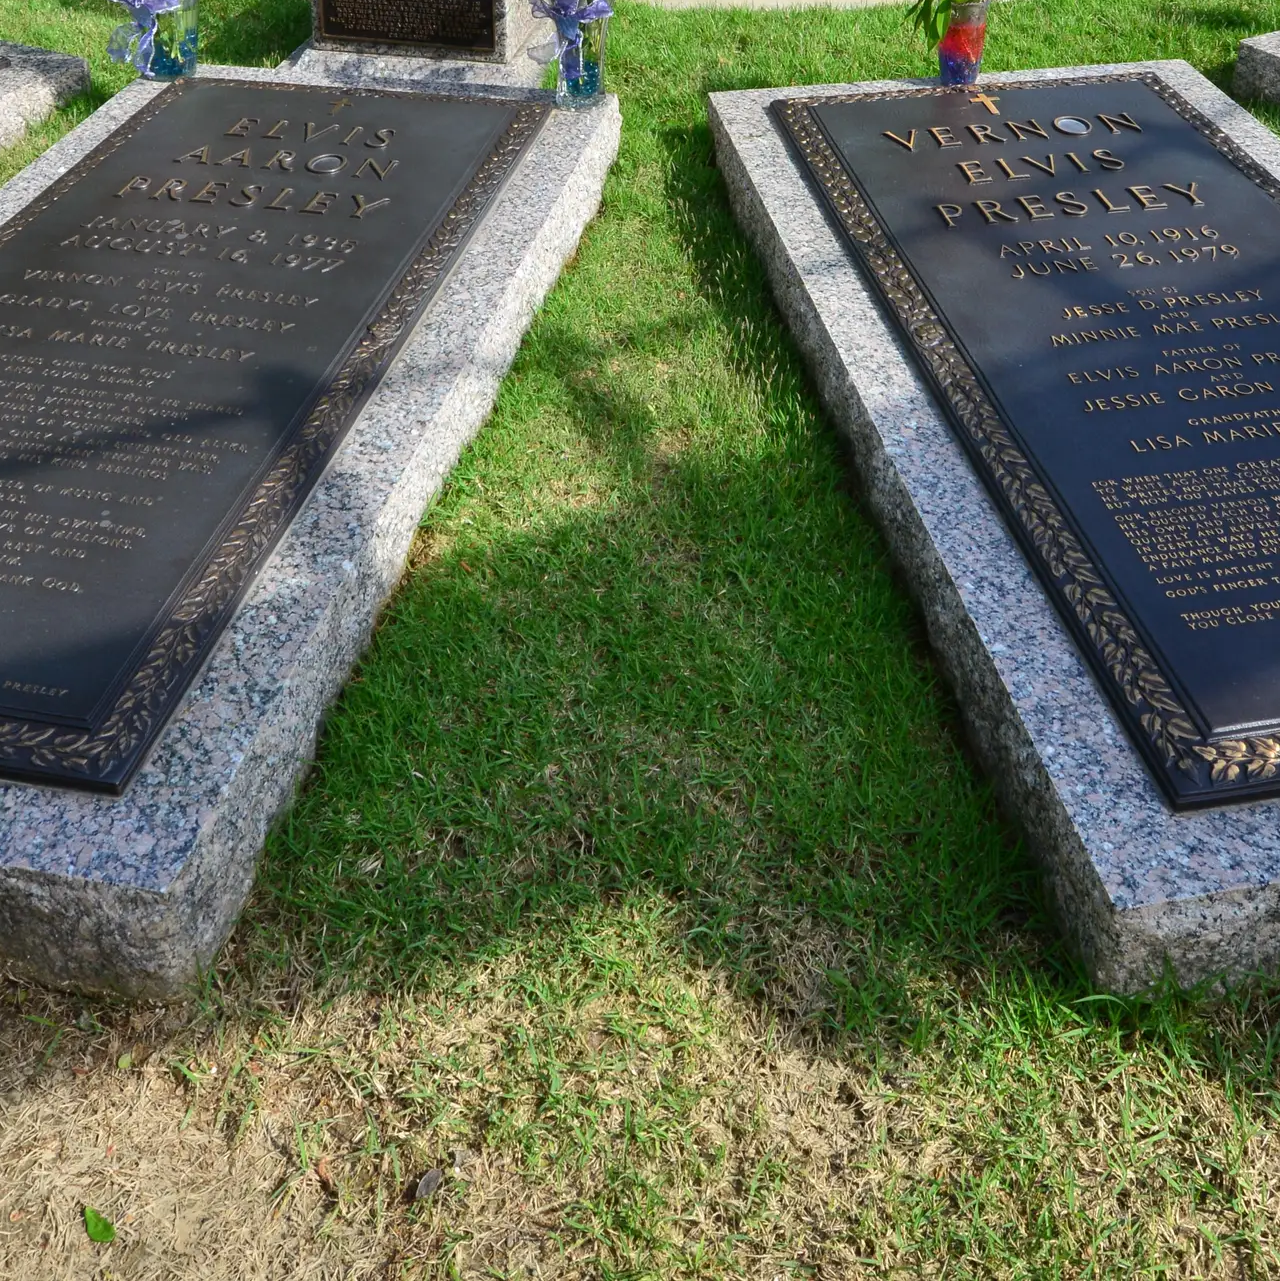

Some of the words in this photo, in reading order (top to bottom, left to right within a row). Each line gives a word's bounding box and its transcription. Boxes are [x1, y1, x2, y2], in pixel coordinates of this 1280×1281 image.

[226, 117, 397, 150] ELVIS
[884, 112, 1142, 152] VERNON
[176, 143, 400, 180] AARON
[958, 148, 1125, 185] ELVIS
[117, 176, 391, 220] PRESLEY
[938, 181, 1205, 227] PRESLEY
[85, 213, 238, 240] JANUARY
[286, 233, 357, 254] 1935
[997, 236, 1092, 259] APRIL
[1103, 231, 1146, 248] 10,
[1150, 224, 1220, 244] 1916
[60, 232, 207, 259] AUGUST
[269, 252, 344, 273] 1977
[1010, 256, 1100, 280] JUNE
[1111, 251, 1161, 268] 26,
[1169, 243, 1242, 264] 1979
[23, 267, 124, 287] VERNON
[135, 278, 201, 295] ELVIS
[215, 286, 320, 307] PRESLEY
[150, 266, 180, 276] SON
[185, 270, 206, 279] OF
[1061, 302, 1128, 320] JESSE
[1137, 299, 1160, 310] D.
[1163, 288, 1263, 309] PRESLEY
[1127, 287, 1158, 298] SON
[1161, 285, 1180, 294] OF
[90, 318, 147, 331] FATHER
[149, 325, 169, 334] OF
[109, 303, 172, 320] LOVE
[188, 311, 296, 334] PRESLEY
[1158, 310, 1190, 320] AND
[47, 328, 131, 349] MARIE
[146, 339, 256, 363] PRESLEY
[1050, 326, 1141, 348] MINNIE
[1150, 320, 1204, 336] MAE
[1162, 345, 1217, 357] FATHER
[1221, 342, 1244, 351] OF
[1067, 366, 1140, 384] ELVIS
[1154, 355, 1243, 376] AARON
[1208, 371, 1244, 382] AND
[1084, 392, 1166, 412] JESSIE
[1178, 379, 1274, 401] GARON
[1130, 434, 1193, 453] LISA
[1091, 479, 1119, 489] FOR
[1121, 474, 1160, 484] WHEN
[1163, 469, 1198, 480] THAT
[1202, 465, 1230, 475] ONE
[1095, 487, 1116, 495] TO
[1121, 481, 1164, 492] WRITE
[1172, 473, 1228, 487] AGAINST
[1234, 468, 1272, 479] YOUR
[1100, 494, 1119, 503] HE
[1126, 487, 1177, 499] WRITES
[1182, 484, 1209, 493] NOT
[1212, 479, 1247, 489] THAT
[1251, 475, 1280, 485] YOU
[1105, 501, 1132, 510] BUT
[1139, 496, 1169, 506] HOW
[1175, 492, 1202, 501] YOU
[1206, 485, 1256, 498] PLAYED
[1155, 573, 1193, 585] LOVE
[1196, 570, 1212, 579] IS
[1215, 562, 1273, 577] PATIENT
[1165, 585, 1208, 599] GOD'S
[1212, 577, 1268, 592] FINGER
[3, 680, 69, 698] PRESLEY
